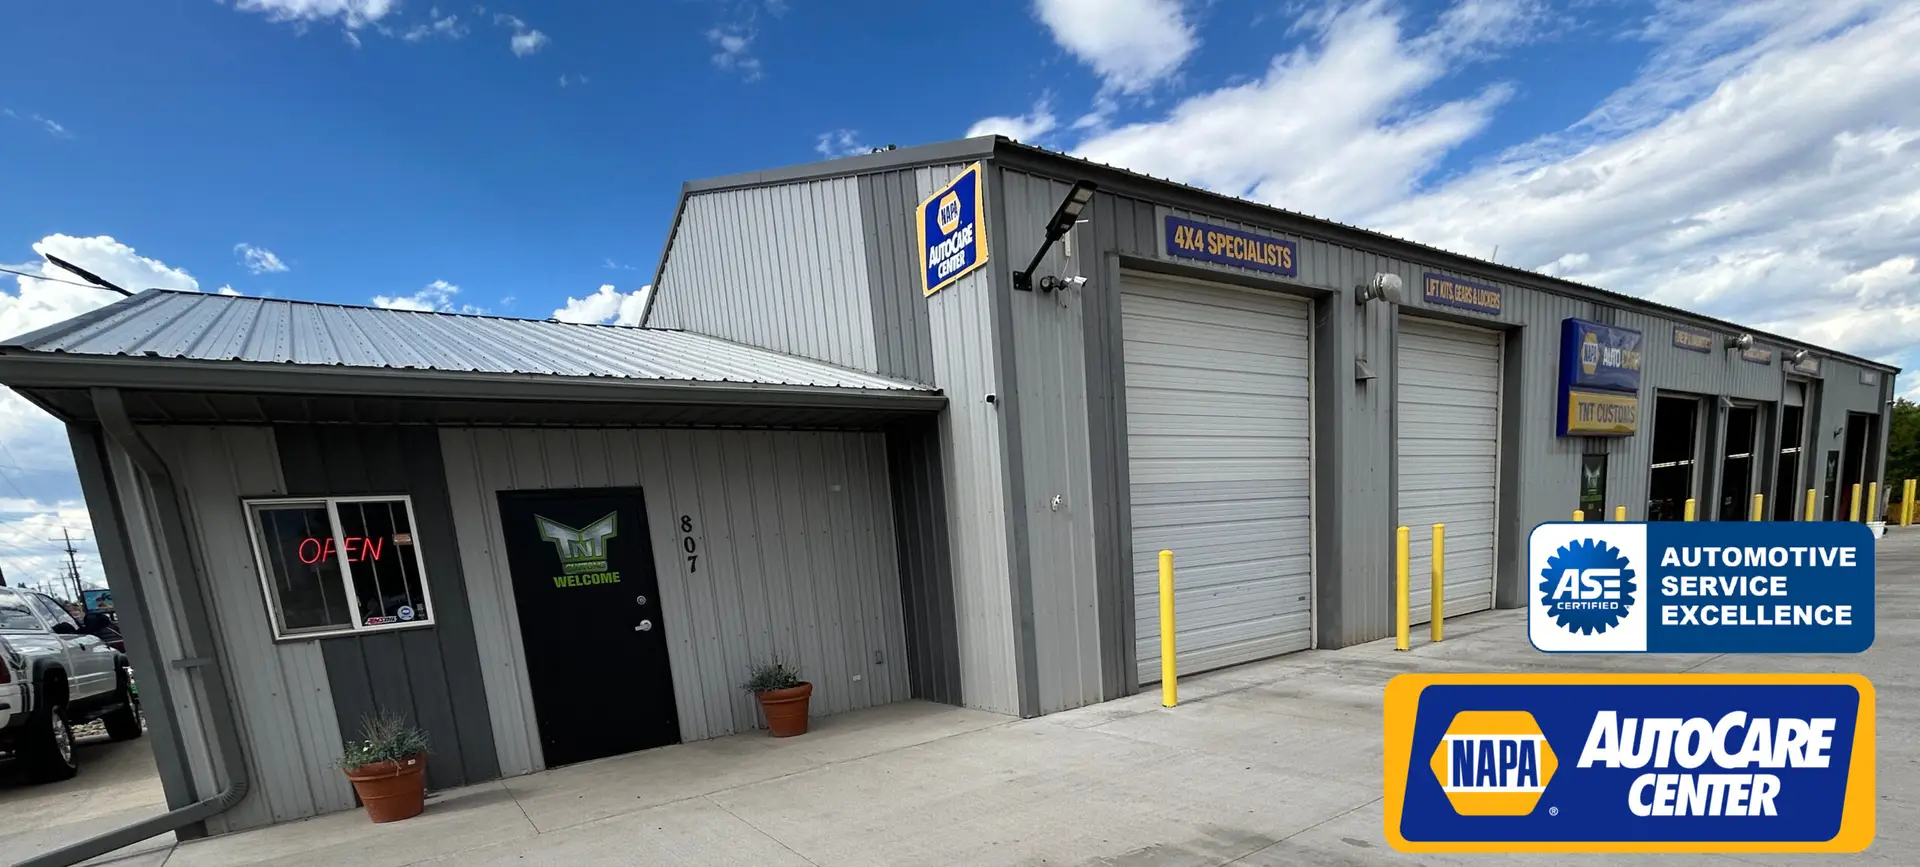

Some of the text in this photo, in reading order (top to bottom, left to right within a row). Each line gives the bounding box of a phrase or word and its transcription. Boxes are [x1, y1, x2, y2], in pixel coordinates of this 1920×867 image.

[941, 200, 959, 226] NAPA
[1174, 225, 1292, 269] 4X4 SPECIALISTS
[938, 249, 966, 279] CENTER
[1426, 277, 1439, 297] LIFT
[1455, 284, 1473, 304] GEARS
[1478, 289, 1500, 309] LOCKERS
[1584, 344, 1598, 363] NAPA
[1602, 346, 1621, 368] AUTO
[1578, 402, 1635, 424] TNT CUSTOMS
[298, 536, 384, 564] OPEN
[538, 513, 615, 560] TNT
[680, 515, 698, 574] 807
[553, 571, 621, 588] WELCOME
